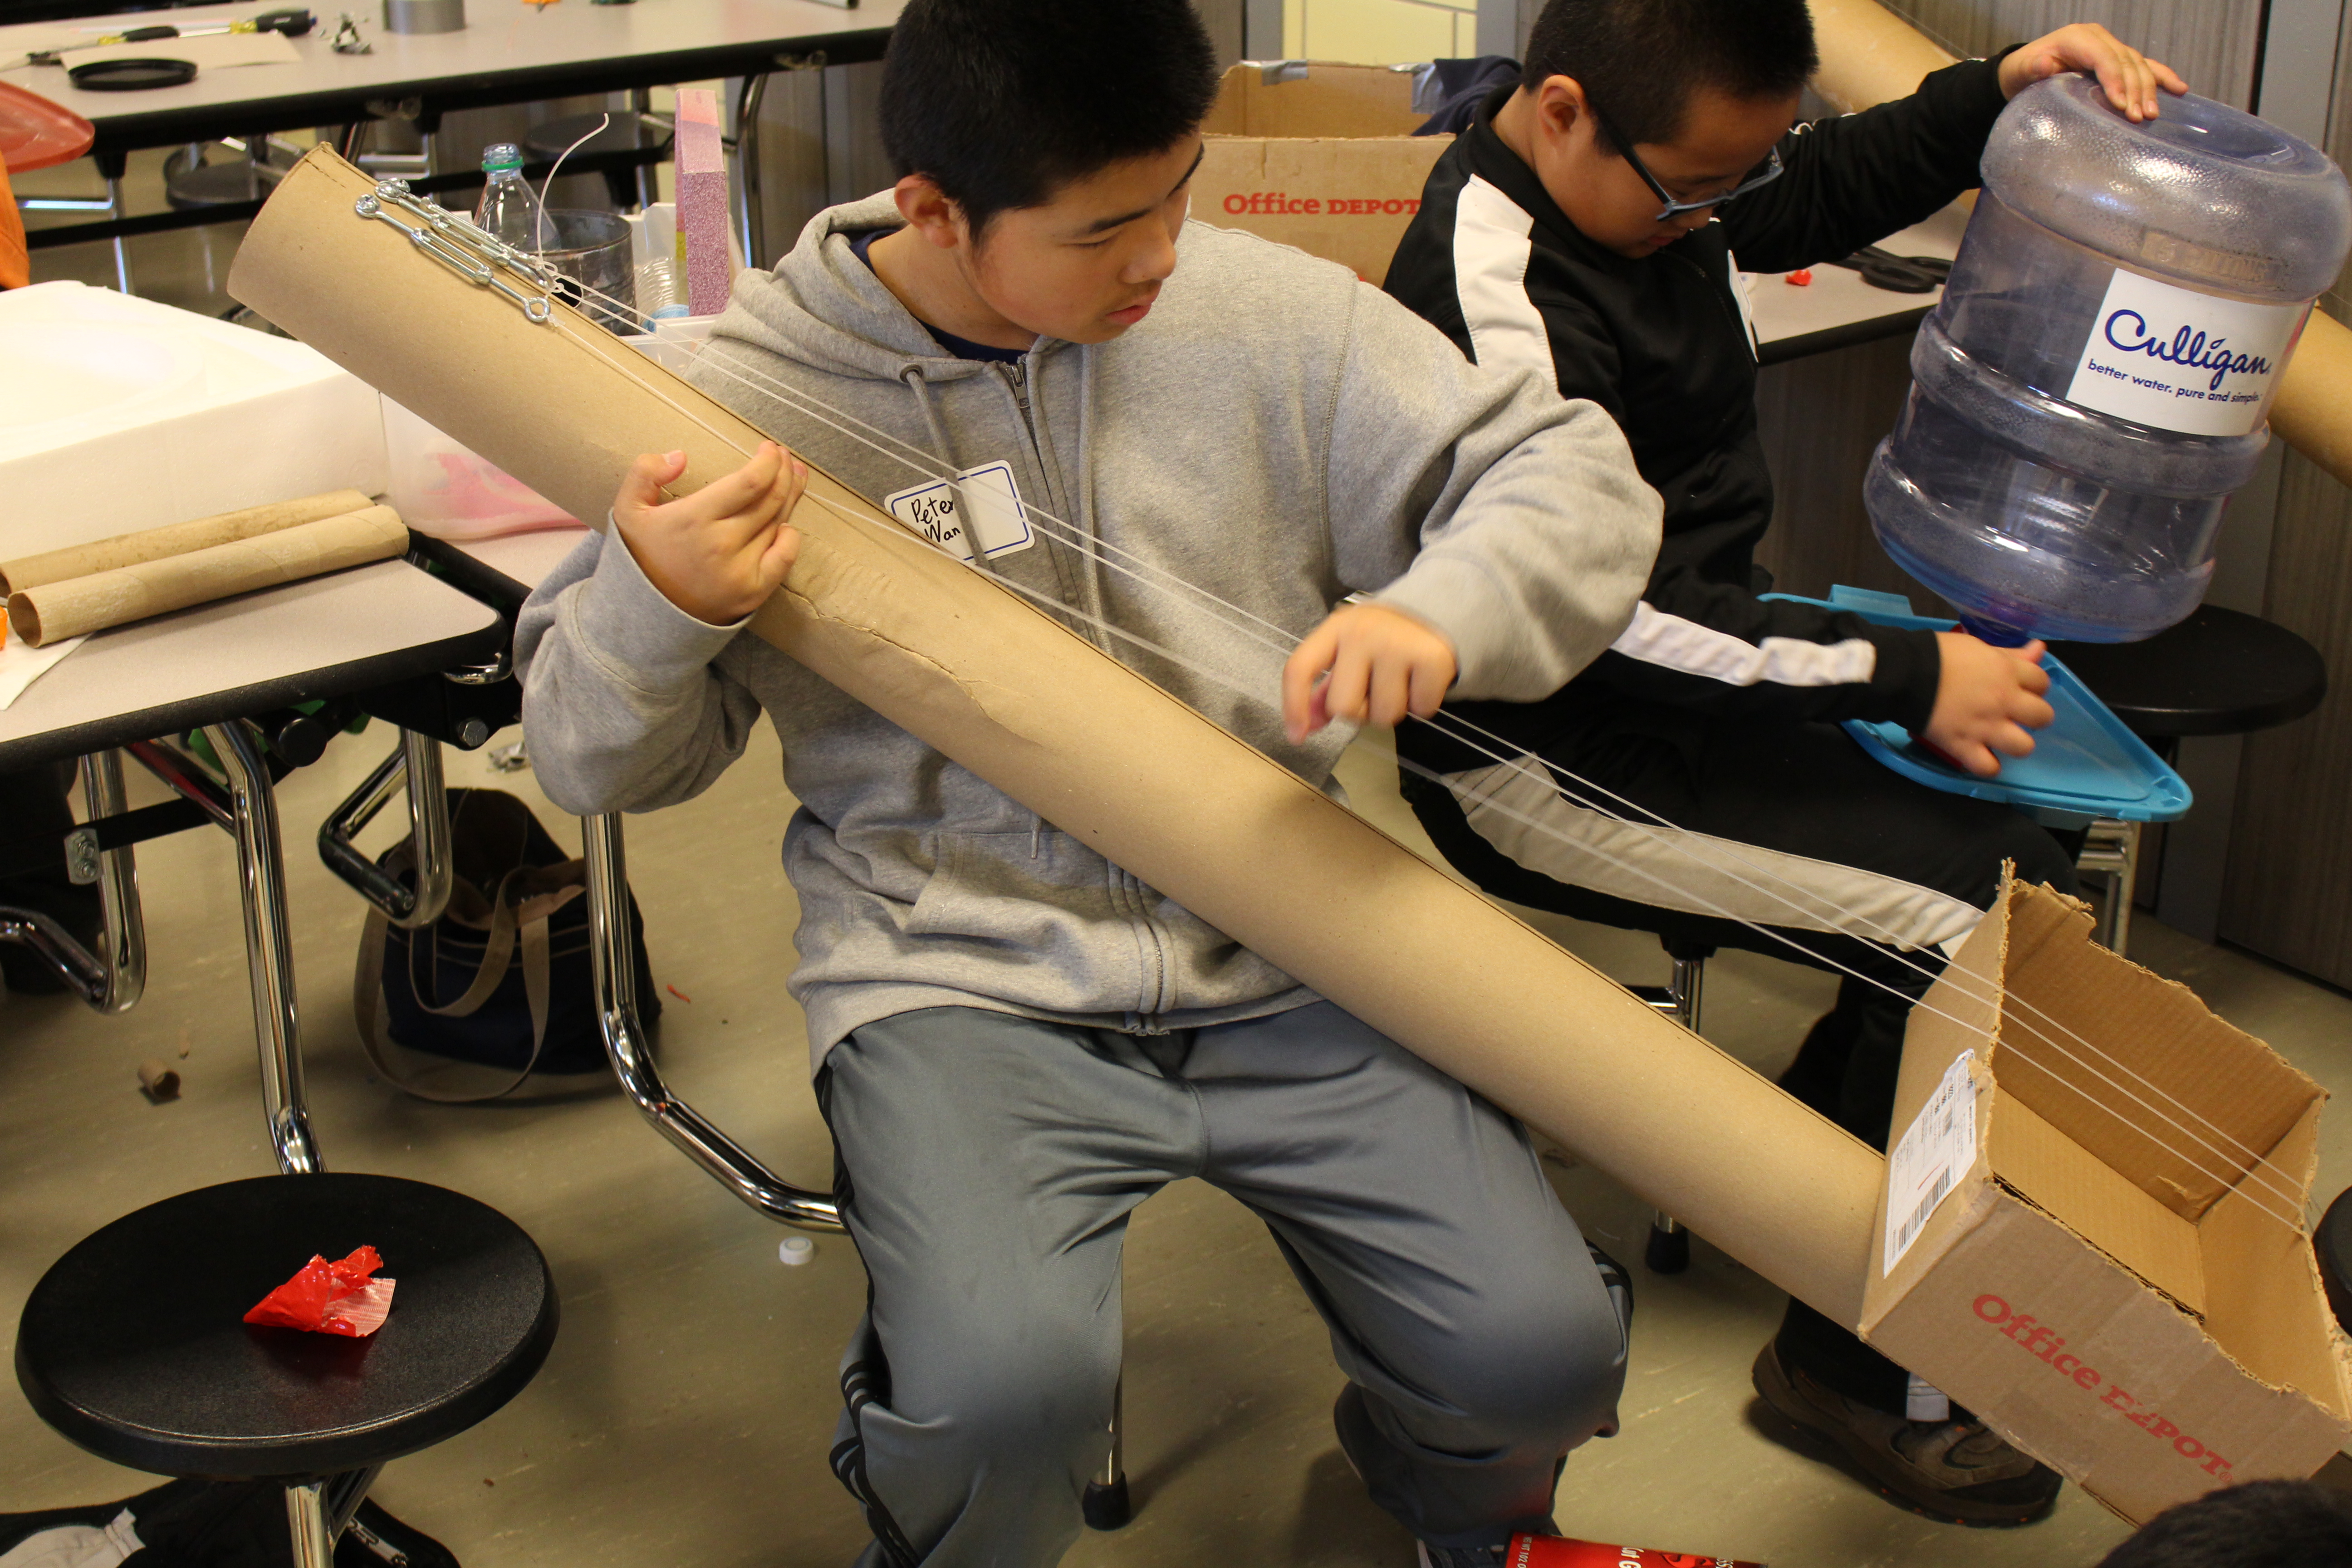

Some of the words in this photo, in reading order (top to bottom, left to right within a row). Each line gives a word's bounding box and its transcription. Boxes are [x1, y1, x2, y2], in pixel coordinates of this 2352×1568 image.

[1224, 192, 1320, 215] Office
[1327, 199, 1422, 215] DEPOT
[2104, 309, 2268, 390] Culligan
[2087, 358, 2128, 381] better
[2132, 375, 2172, 393] water.
[2176, 387, 2205, 398] pure
[2208, 391, 2230, 402] and
[911, 496, 953, 524] Peter
[1972, 1294, 2102, 1390] Office
[1518, 1552, 1529, 1563] 102
